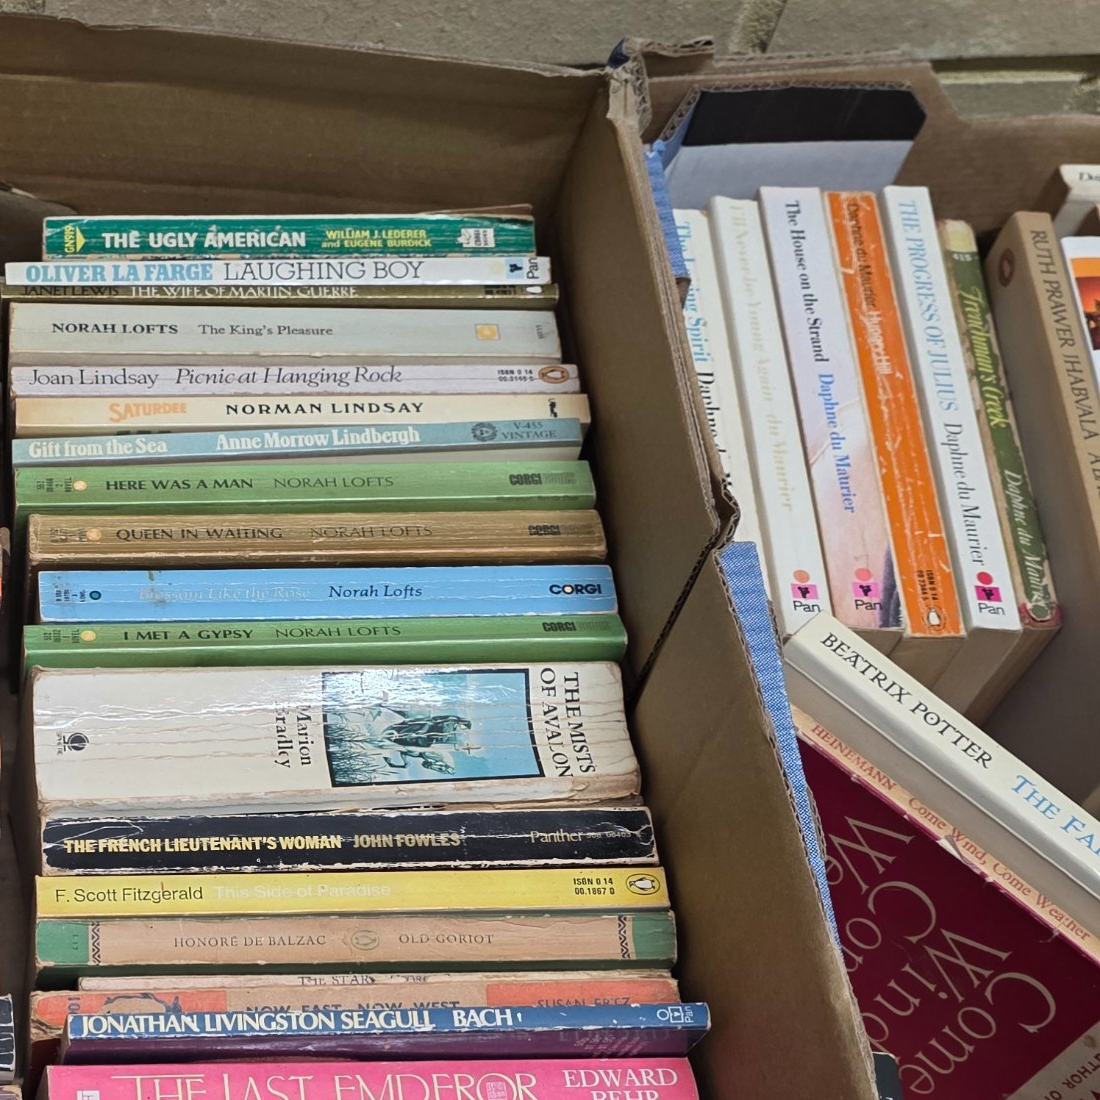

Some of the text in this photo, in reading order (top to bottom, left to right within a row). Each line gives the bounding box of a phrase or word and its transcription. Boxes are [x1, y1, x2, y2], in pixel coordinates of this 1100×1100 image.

[102, 231, 307, 249] THE UGLY AMERICAN
[52, 323, 333, 336] NORAH LOFTS The King's Pleasure
[1031, 229, 1099, 441] RUTH PRAWER JHABVALA
[785, 200, 855, 513] The House on the Strand Daphne du Maurier
[898, 200, 988, 566] THE PROGRESS OF JULIUS Daphne du Maurier
[109, 402, 424, 423] SATURDEE NORMAN LINDSAY
[28, 426, 421, 458] Gift from the Sea Anne Morrow Lindbergh
[793, 601, 821, 613] Pan
[978, 602, 1005, 616] Pan
[540, 667, 573, 778] OF AVALON
[564, 672, 596, 774] THE MISTS
[820, 632, 1062, 821] BEATRIX POTTER THE
[65, 833, 461, 853] THE FRENCH LIEUTENANT'S WOMAN JOHN FOWLES
[174, 933, 494, 948] HONORÉ DE BALZAC OLD GORIOT
[562, 1068, 678, 1089] EDWARD
